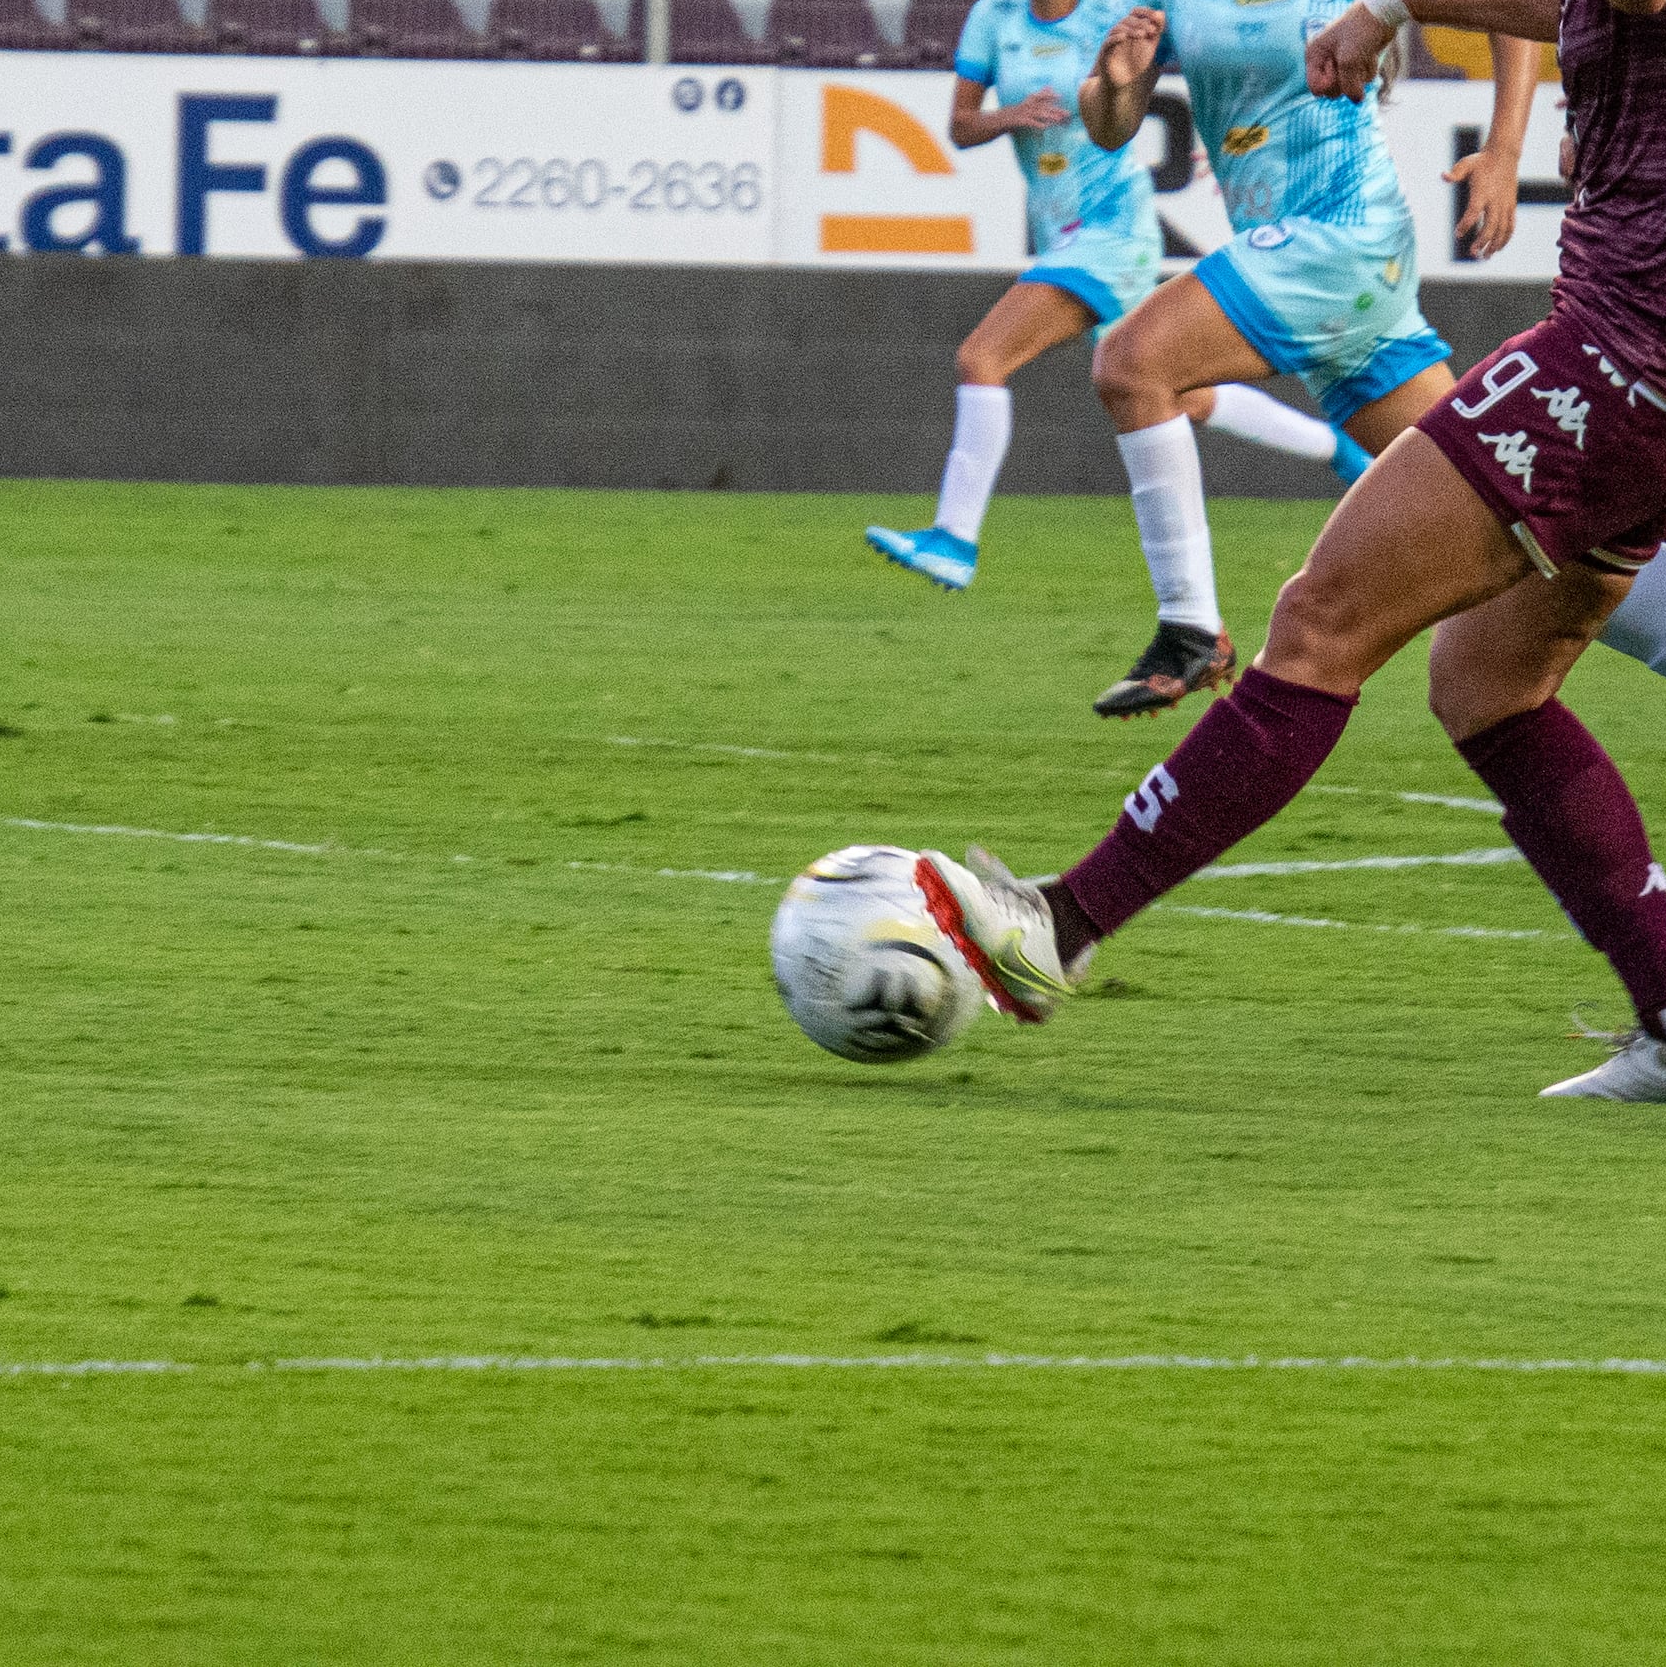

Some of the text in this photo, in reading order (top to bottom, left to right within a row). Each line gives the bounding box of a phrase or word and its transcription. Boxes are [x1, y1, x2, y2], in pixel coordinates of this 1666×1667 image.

[175, 93, 389, 259] Fe
[470, 155, 766, 216] 2260-2636
[1450, 350, 1539, 420] 9
